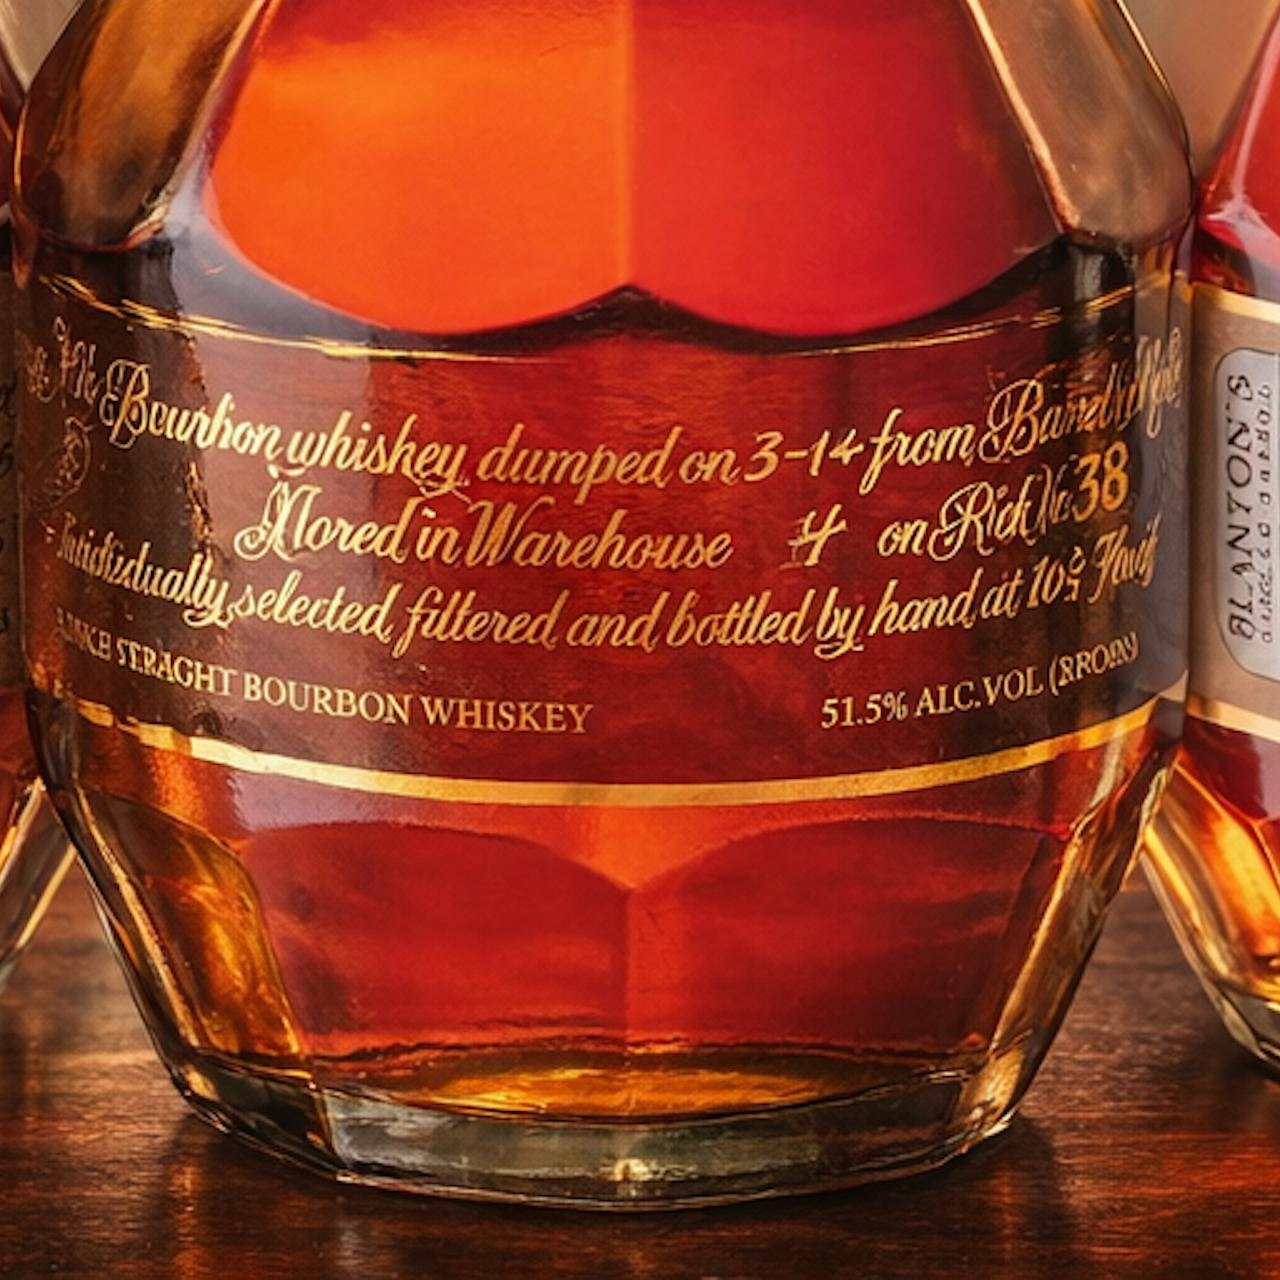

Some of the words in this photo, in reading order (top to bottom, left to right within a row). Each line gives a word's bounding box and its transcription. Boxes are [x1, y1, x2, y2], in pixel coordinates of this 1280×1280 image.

[286, 413, 471, 497] whiskey
[475, 422, 685, 507] dumped
[678, 446, 745, 486] on
[857, 407, 977, 497] from
[416, 505, 462, 564] in
[464, 495, 734, 571] Warehouse
[876, 519, 929, 558] on
[1072, 440, 1130, 523] 38
[230, 570, 403, 646] selected
[392, 585, 560, 659] filtered
[565, 589, 661, 654] and
[665, 588, 817, 648] bottled
[812, 586, 867, 661] by
[866, 566, 984, 637] hand
[980, 567, 1025, 620] at
[243, 671, 413, 726] BOURBON
[419, 695, 595, 734] WHISKEY
[820, 691, 909, 729] 51.5%
